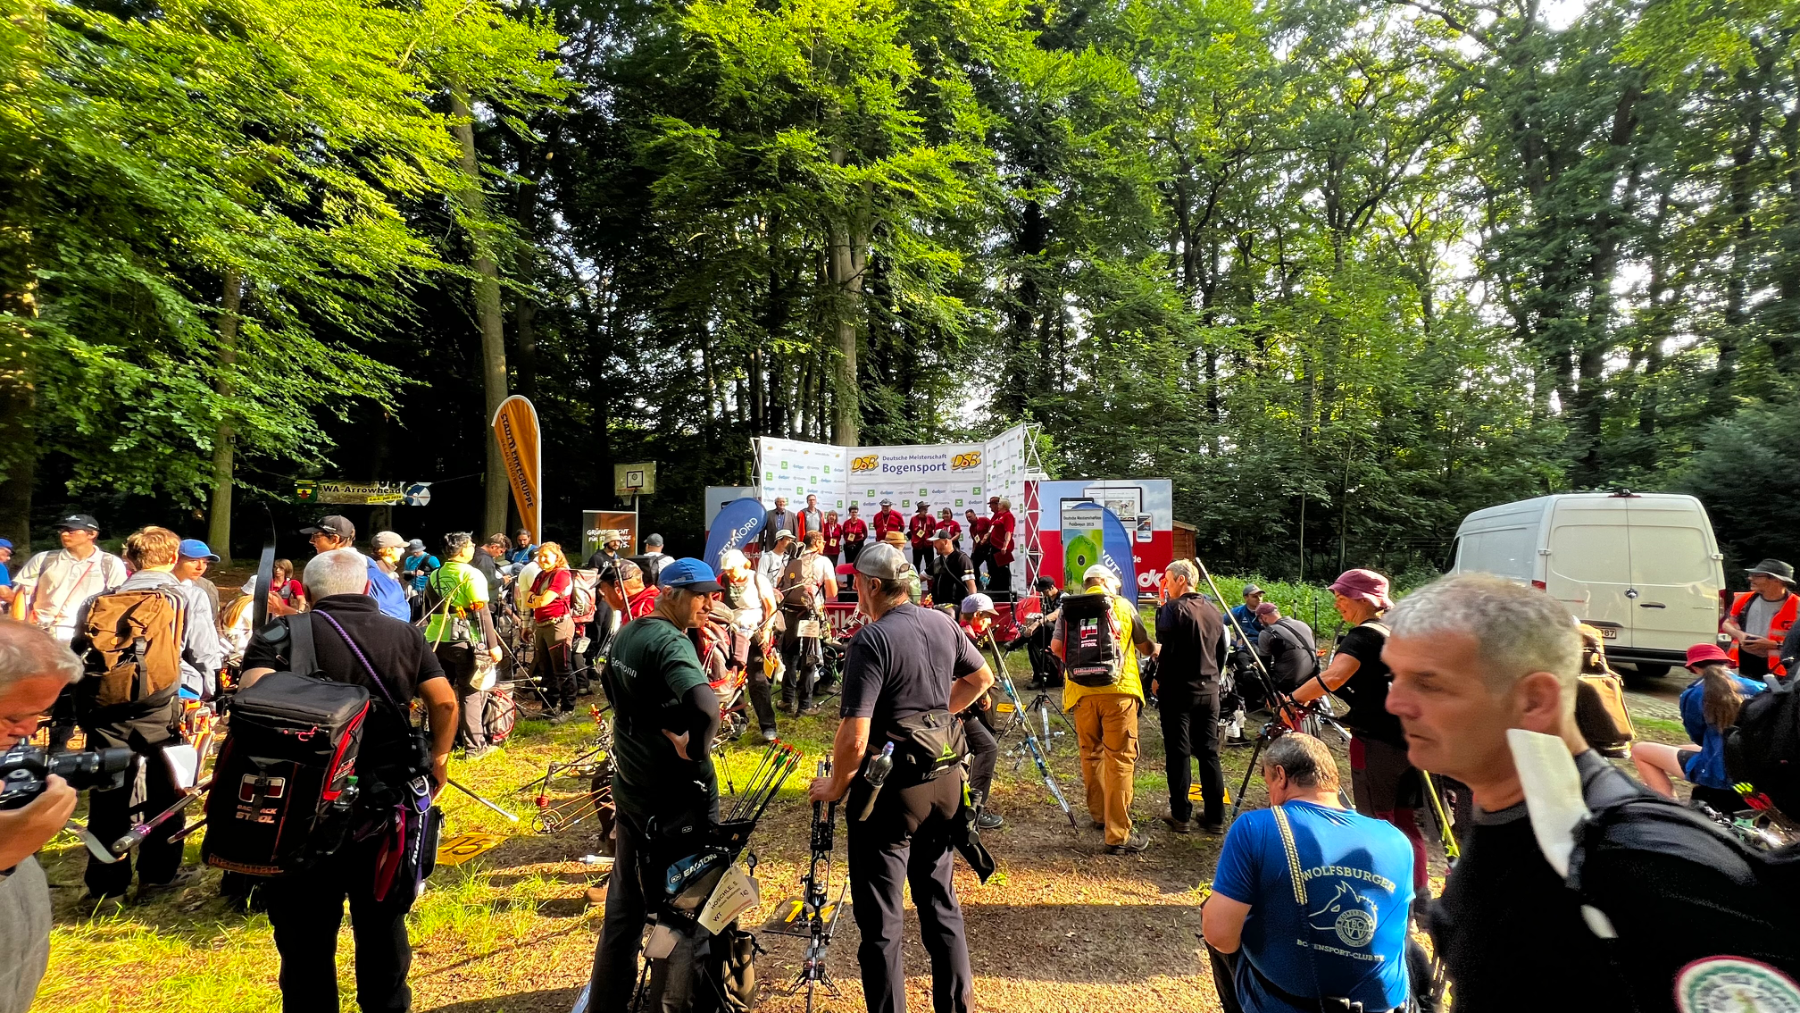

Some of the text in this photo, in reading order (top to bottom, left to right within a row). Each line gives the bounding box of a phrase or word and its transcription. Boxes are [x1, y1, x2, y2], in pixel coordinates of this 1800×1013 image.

[850, 451, 879, 472] DSB
[882, 462, 947, 475] Bogensport
[951, 450, 981, 470] DSB
[322, 484, 401, 494] WA-Arrowhead
[734, 517, 758, 542] NORD
[1138, 569, 1164, 588] dk
[235, 811, 275, 823] STOL
[237, 804, 278, 815] BACACK
[683, 853, 718, 877] EASTON
[1301, 865, 1397, 893] WOLFSBURGER
